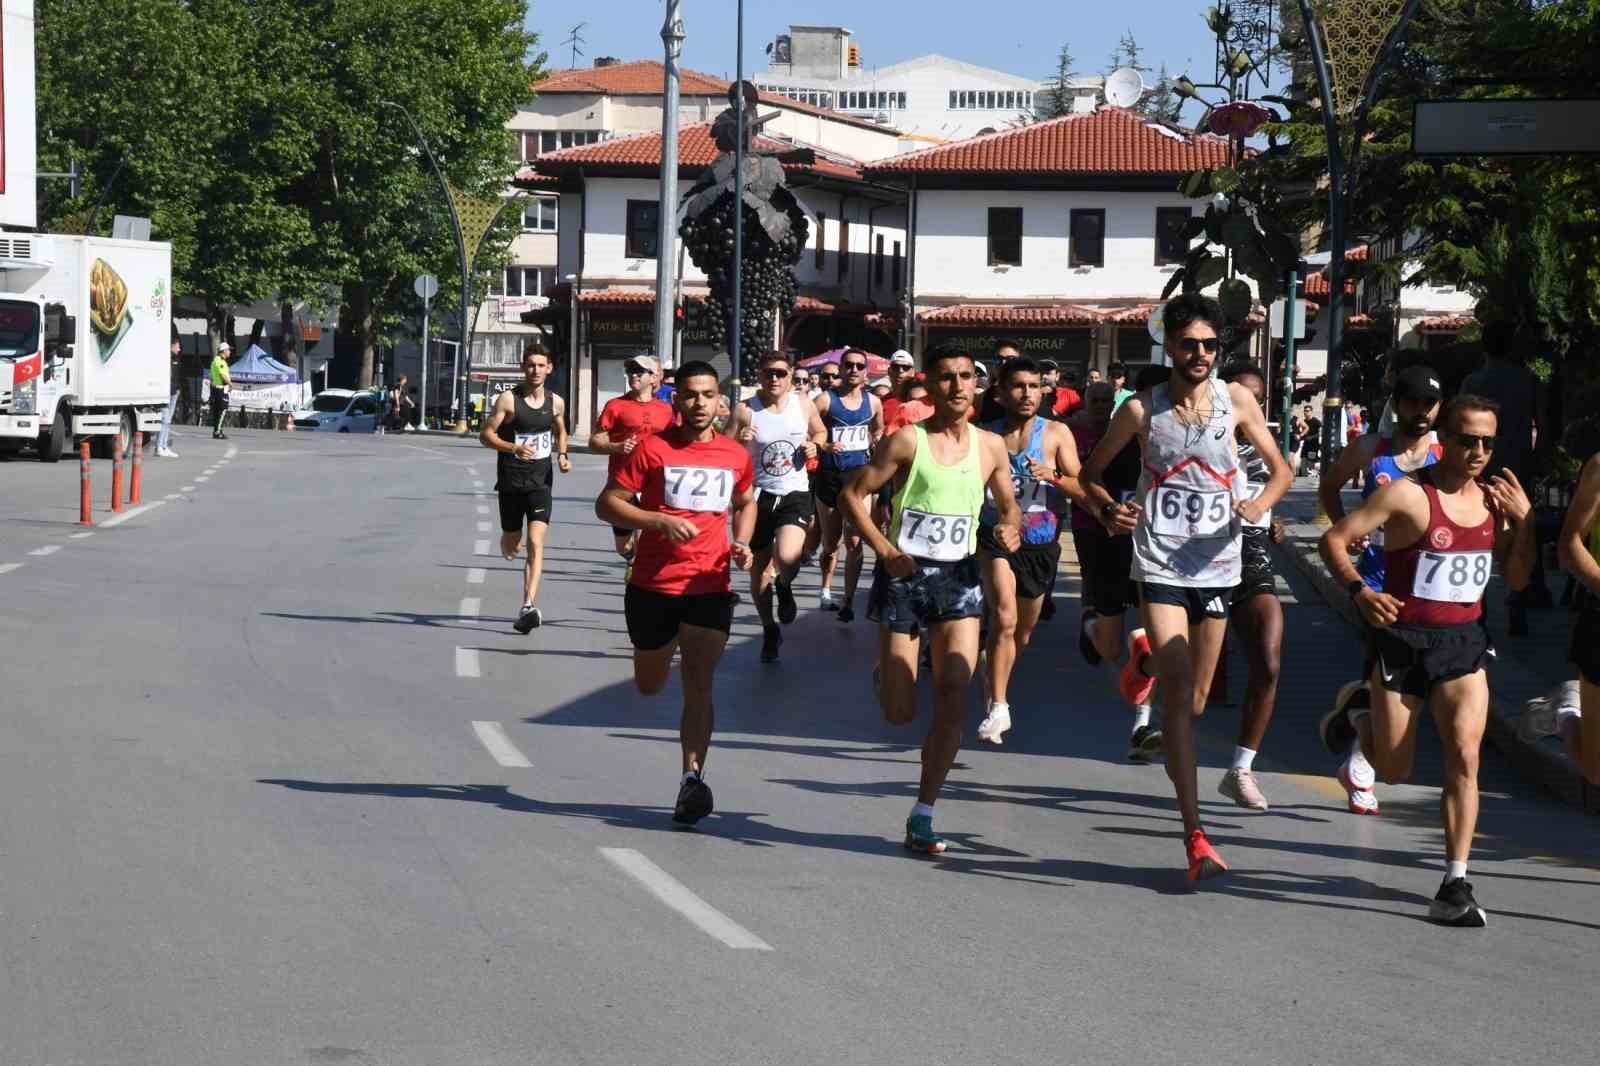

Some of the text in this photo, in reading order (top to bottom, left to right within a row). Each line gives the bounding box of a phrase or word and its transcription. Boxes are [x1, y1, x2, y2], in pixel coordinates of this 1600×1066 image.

[518, 433, 549, 451] 718
[835, 426, 867, 443] 770
[670, 468, 726, 498] 721
[1160, 489, 1226, 524] 695
[907, 511, 967, 545] 736
[1424, 552, 1488, 587] 788
